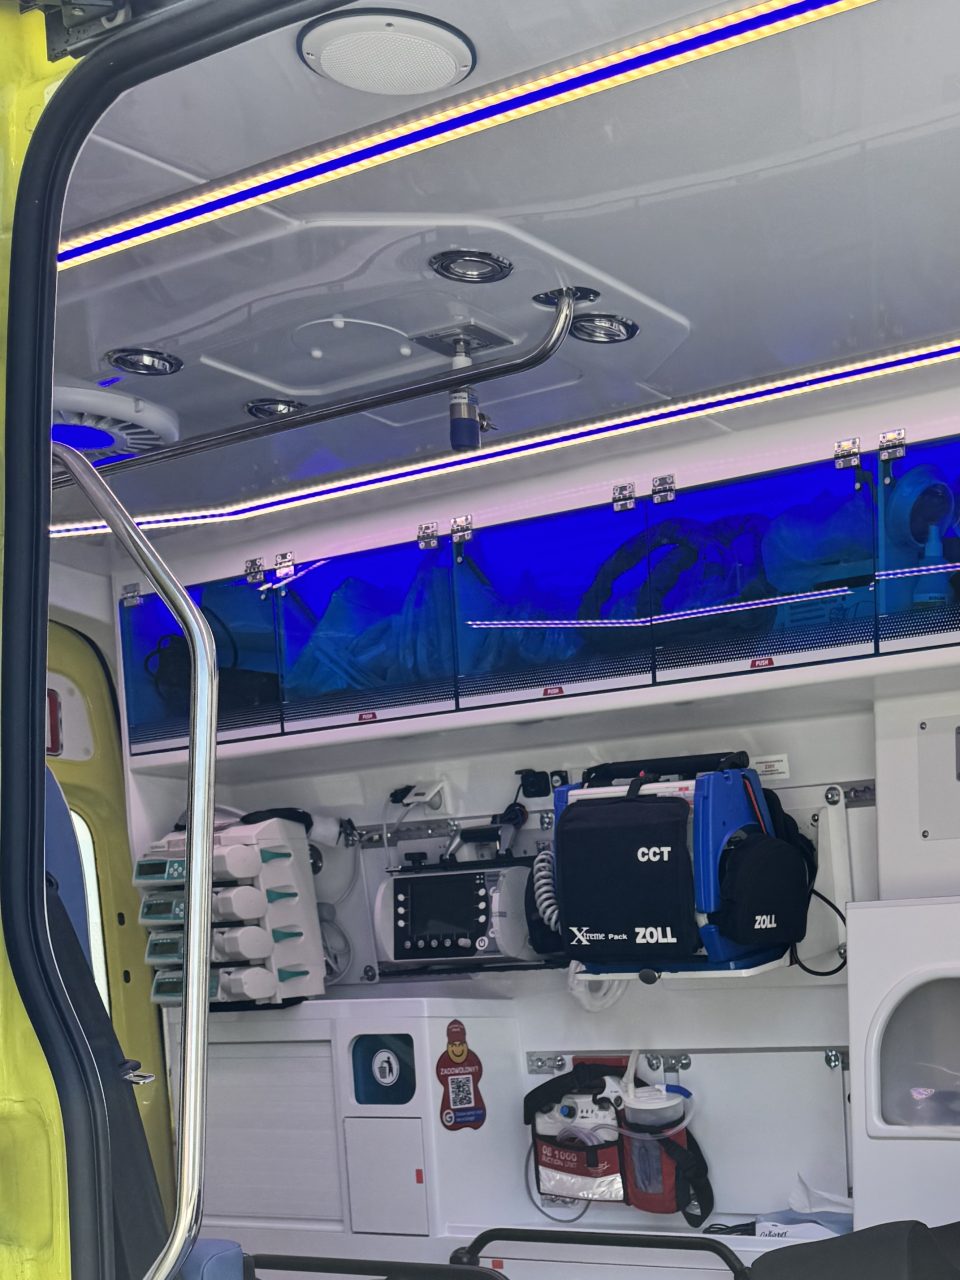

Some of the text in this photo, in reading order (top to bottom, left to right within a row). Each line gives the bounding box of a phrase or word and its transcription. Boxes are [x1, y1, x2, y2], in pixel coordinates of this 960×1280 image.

[637, 846, 671, 862] CCT
[754, 914, 777, 929] ZOLL
[569, 926, 605, 945] Xtreme
[635, 926, 677, 943] ZOLL
